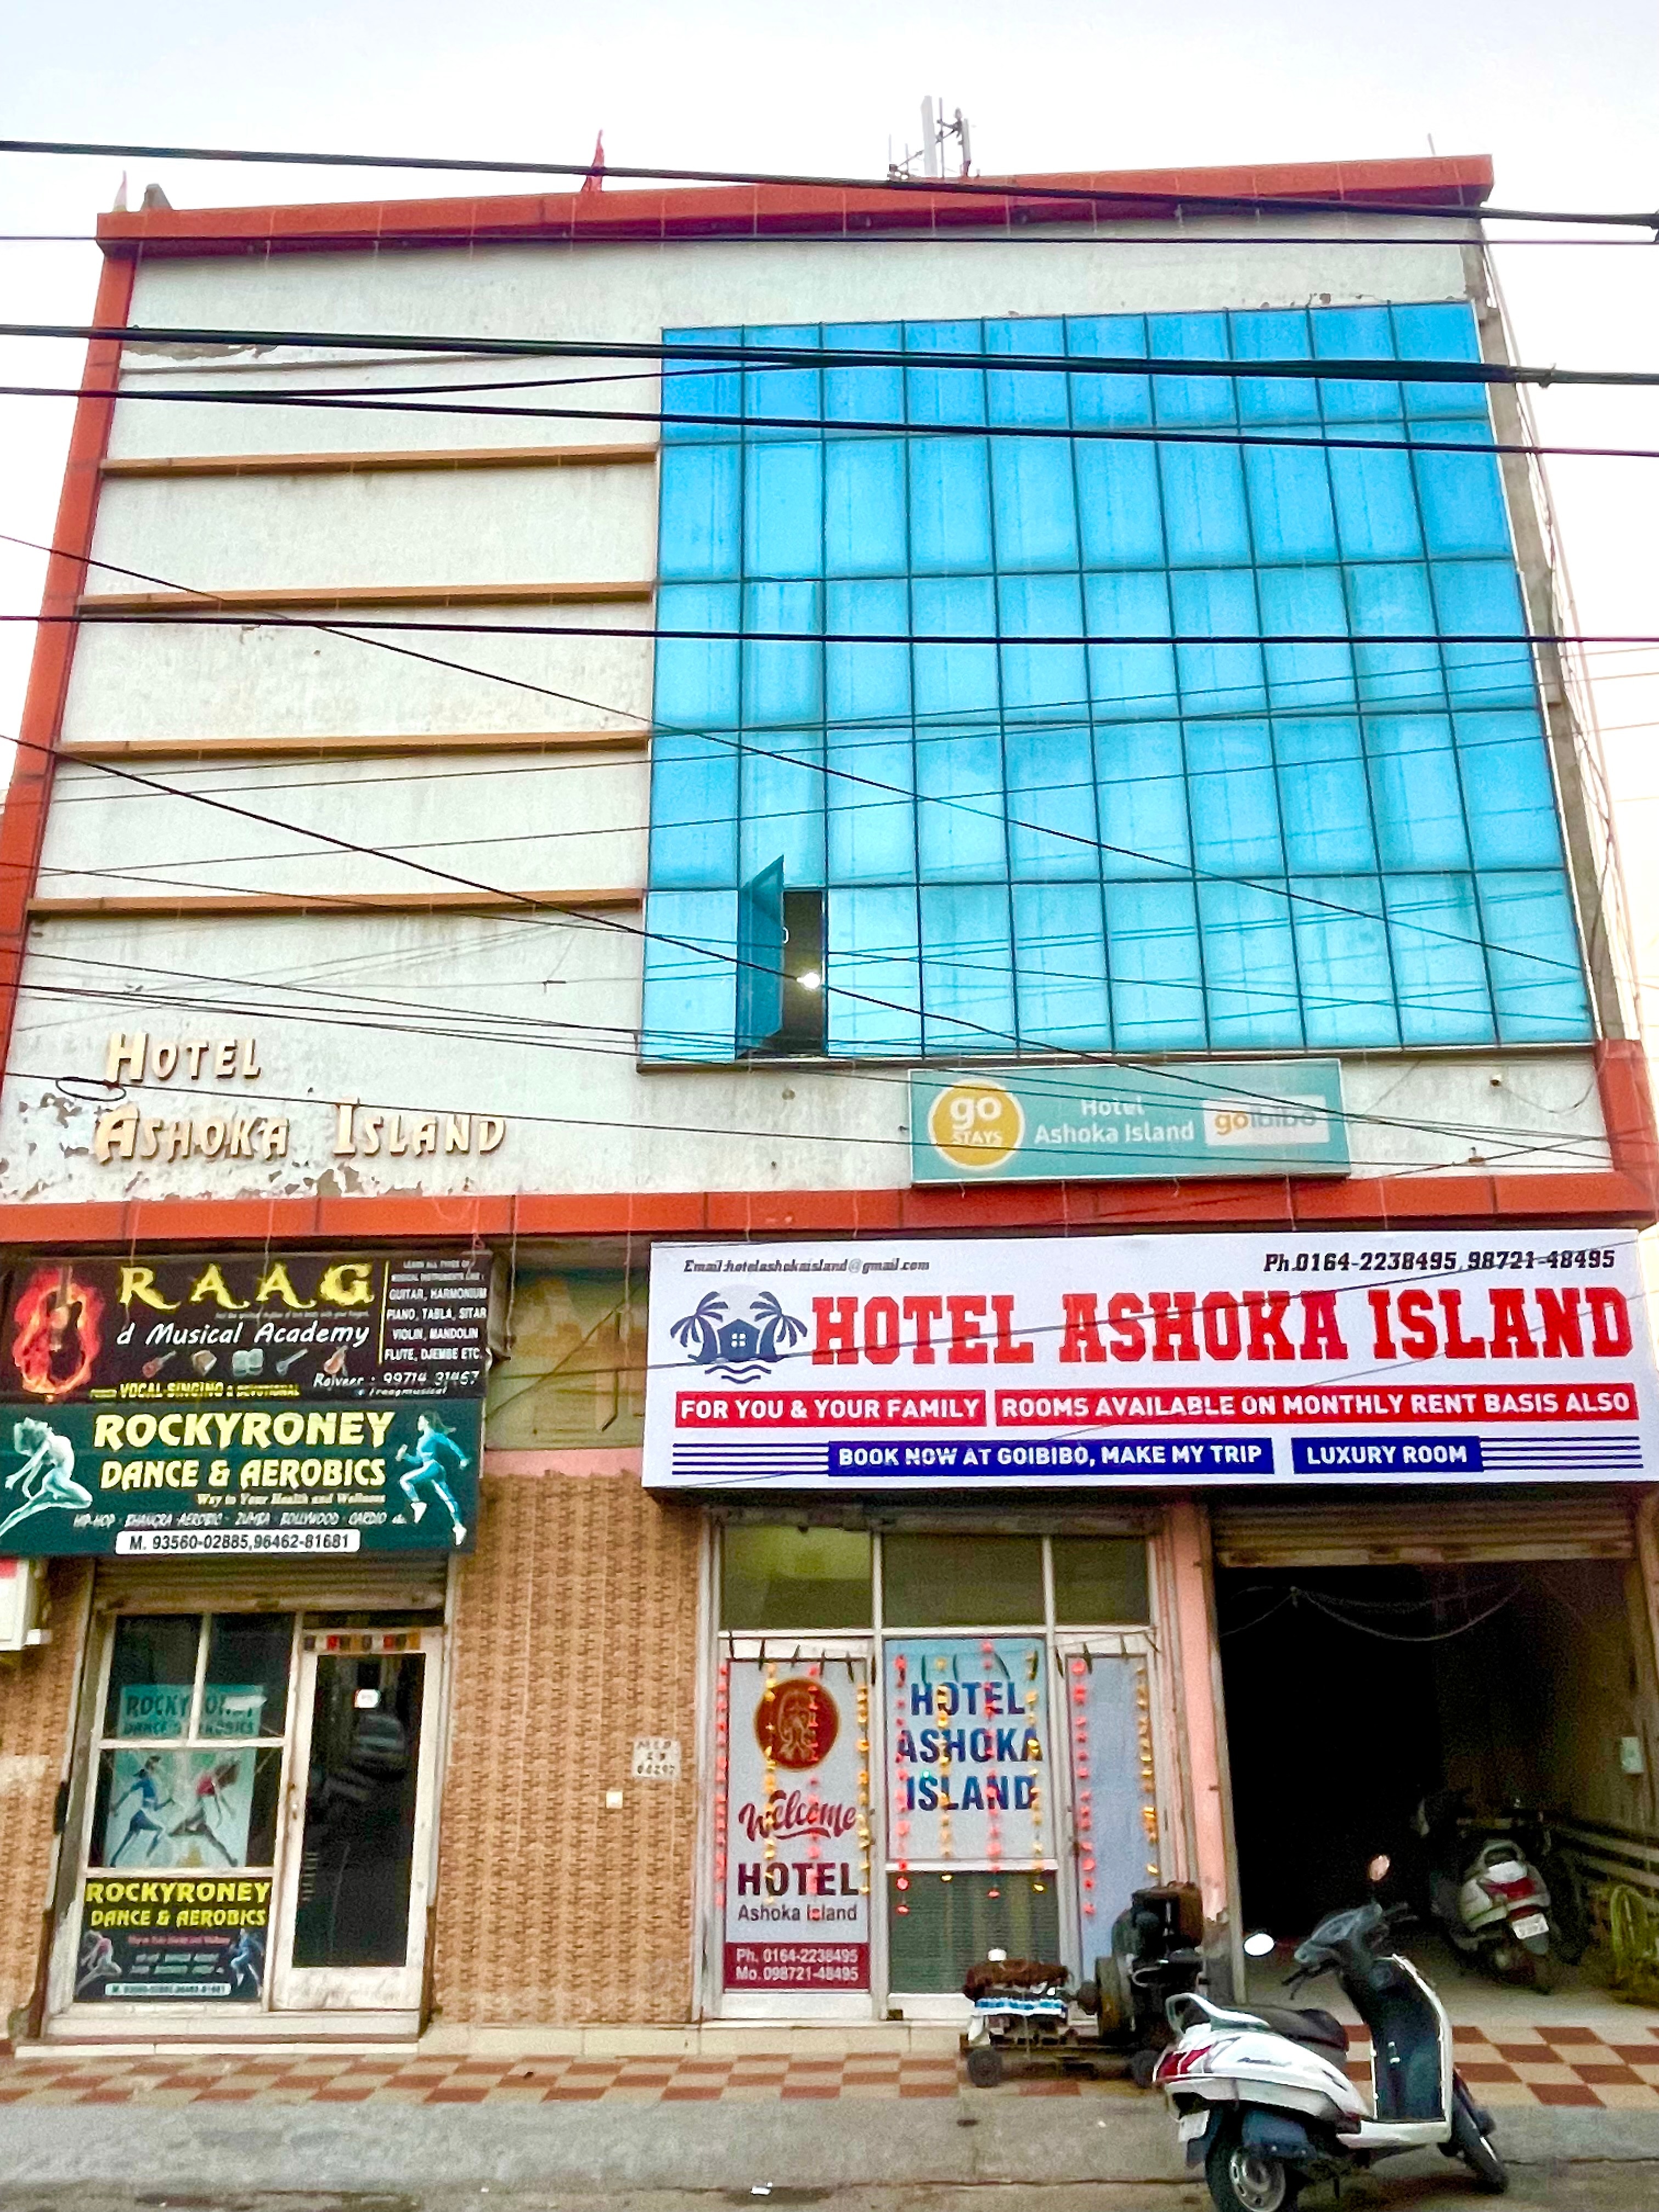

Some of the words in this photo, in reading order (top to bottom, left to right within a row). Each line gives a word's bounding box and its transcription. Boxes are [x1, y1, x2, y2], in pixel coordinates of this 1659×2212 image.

[108, 1032, 262, 1083] HOTEL
[950, 1097, 1002, 1130] go
[1081, 1097, 1145, 1116] Hotel
[94, 1104, 290, 1165] ASHOKA
[332, 1096, 507, 1156] ISLAND
[952, 1131, 1003, 1146] STAYS
[1034, 1122, 1119, 1144] Ashoka
[1125, 1120, 1195, 1143] Island
[119, 1262, 375, 1310] RAAG
[145, 1322, 244, 1345] Musical
[254, 1320, 370, 1347] Academy
[812, 1295, 1034, 1365] HOTEL
[1059, 1290, 1348, 1362] ASHOKA
[1368, 1287, 1634, 1361] ISLAND
[681, 1400, 729, 1419] FOR
[738, 1400, 784, 1419] YOU
[790, 1400, 808, 1419] &
[816, 1399, 880, 1419] YOUR
[887, 1398, 980, 1418] FAMILY
[1002, 1397, 1089, 1418] ROOMS
[1095, 1395, 1235, 1417] AVAILABLE
[1241, 1396, 1275, 1415] ON
[1283, 1394, 1403, 1414] MONTHLY
[1410, 1393, 1477, 1413] RENT
[1483, 1392, 1559, 1413] BASIS
[1565, 1392, 1629, 1412] ALSO
[93, 1412, 395, 1451] ROCKYRONEY
[839, 1448, 898, 1467] BOOK
[905, 1448, 958, 1465] NOW
[963, 1447, 991, 1465] AT
[997, 1446, 1096, 1468] GOIBIBO,
[1102, 1445, 1167, 1464] MAKE
[1172, 1445, 1204, 1464] MY
[1210, 1444, 1263, 1464] TRIP
[1307, 1446, 1396, 1465] LUXURY
[1403, 1444, 1468, 1463] ROOM
[100, 1459, 199, 1491] DANCE
[208, 1459, 230, 1487] &
[240, 1458, 386, 1490] AEROBICS
[911, 1680, 1025, 1716] HOTEL
[896, 1728, 1043, 1762] ASHOKA
[906, 1775, 1035, 1810] ISLAND
[738, 1790, 856, 1841] Welcome
[737, 1862, 859, 1896] HOTEL
[86, 1882, 270, 1904] ROCKYRONEY
[91, 1910, 151, 1927] DANCE
[156, 1910, 170, 1926] &
[176, 1909, 266, 1927] AEROBICS
[738, 1904, 800, 1921] Ashoka
[736, 1948, 758, 1962] Ph.
[763, 1948, 858, 1963] 0164-2238495
[736, 1966, 761, 1980] Mo.
